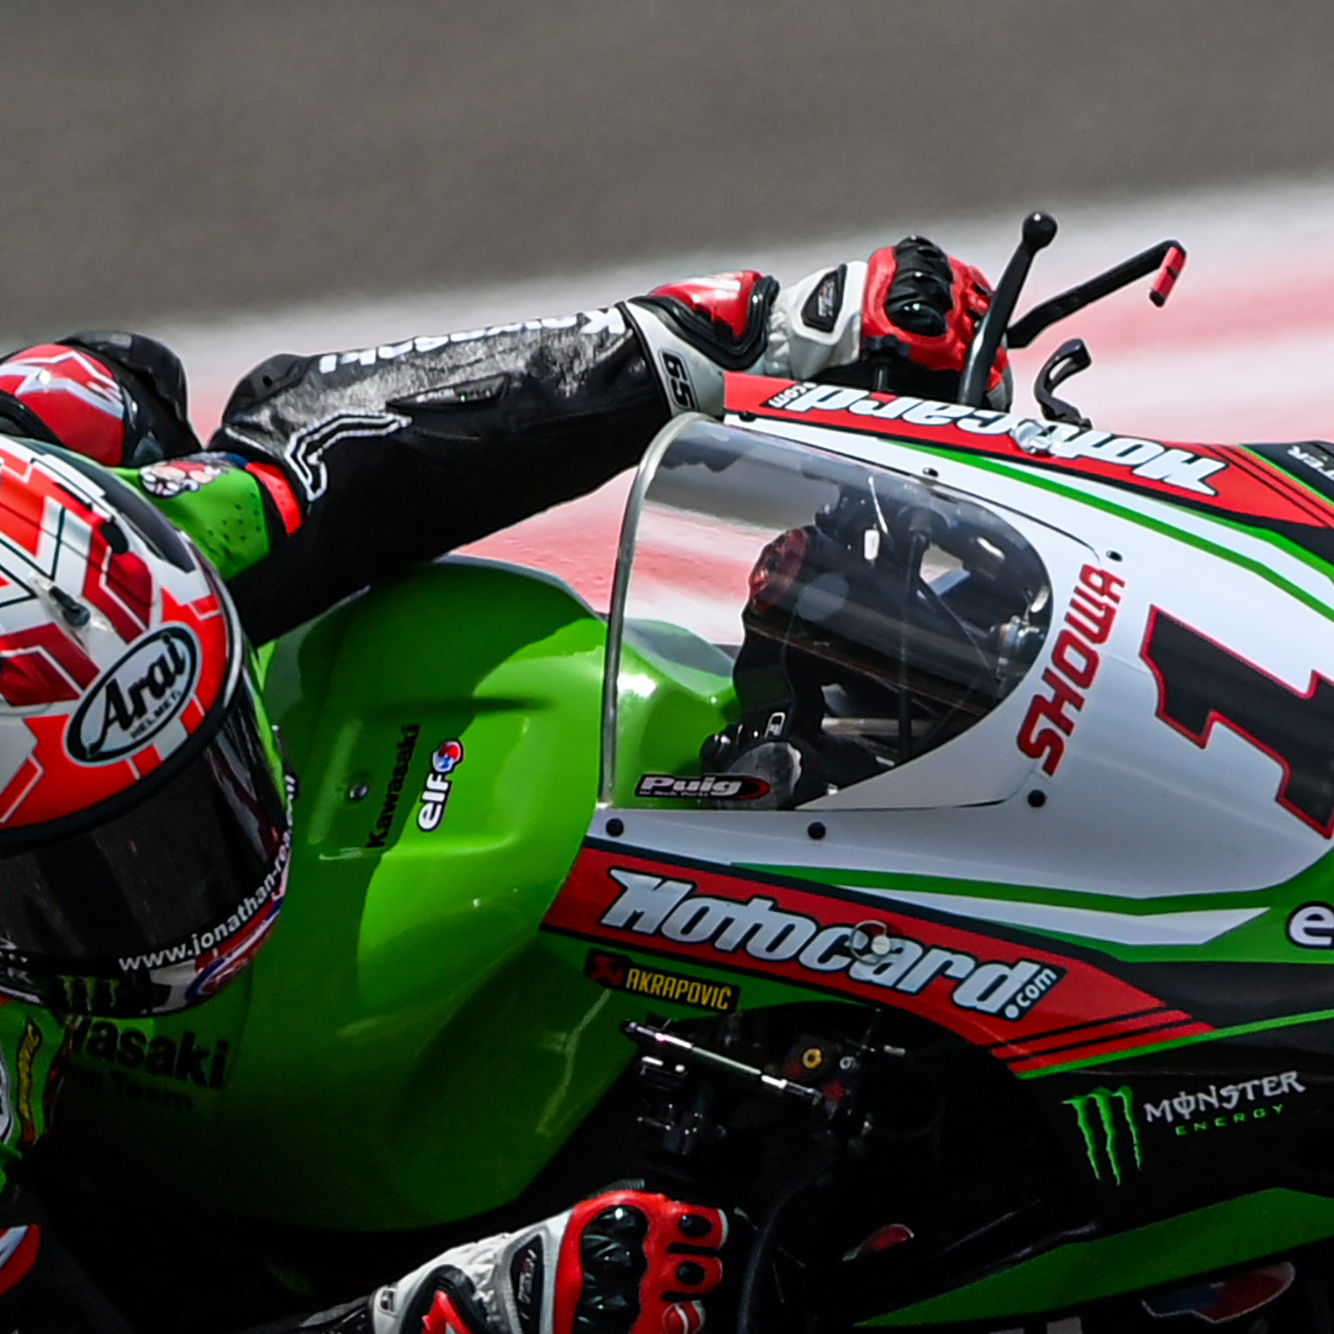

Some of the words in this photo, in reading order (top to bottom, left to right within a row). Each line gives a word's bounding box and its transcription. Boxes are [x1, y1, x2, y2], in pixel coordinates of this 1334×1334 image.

[661, 352, 695, 409] 65
[87, 632, 187, 757] Arai
[1017, 564, 1126, 777] SHOWA
[364, 724, 420, 849] Kawasaki
[417, 772, 450, 831] elf
[638, 775, 744, 798] Puig
[1174, 1103, 1286, 1137] ENERGY
